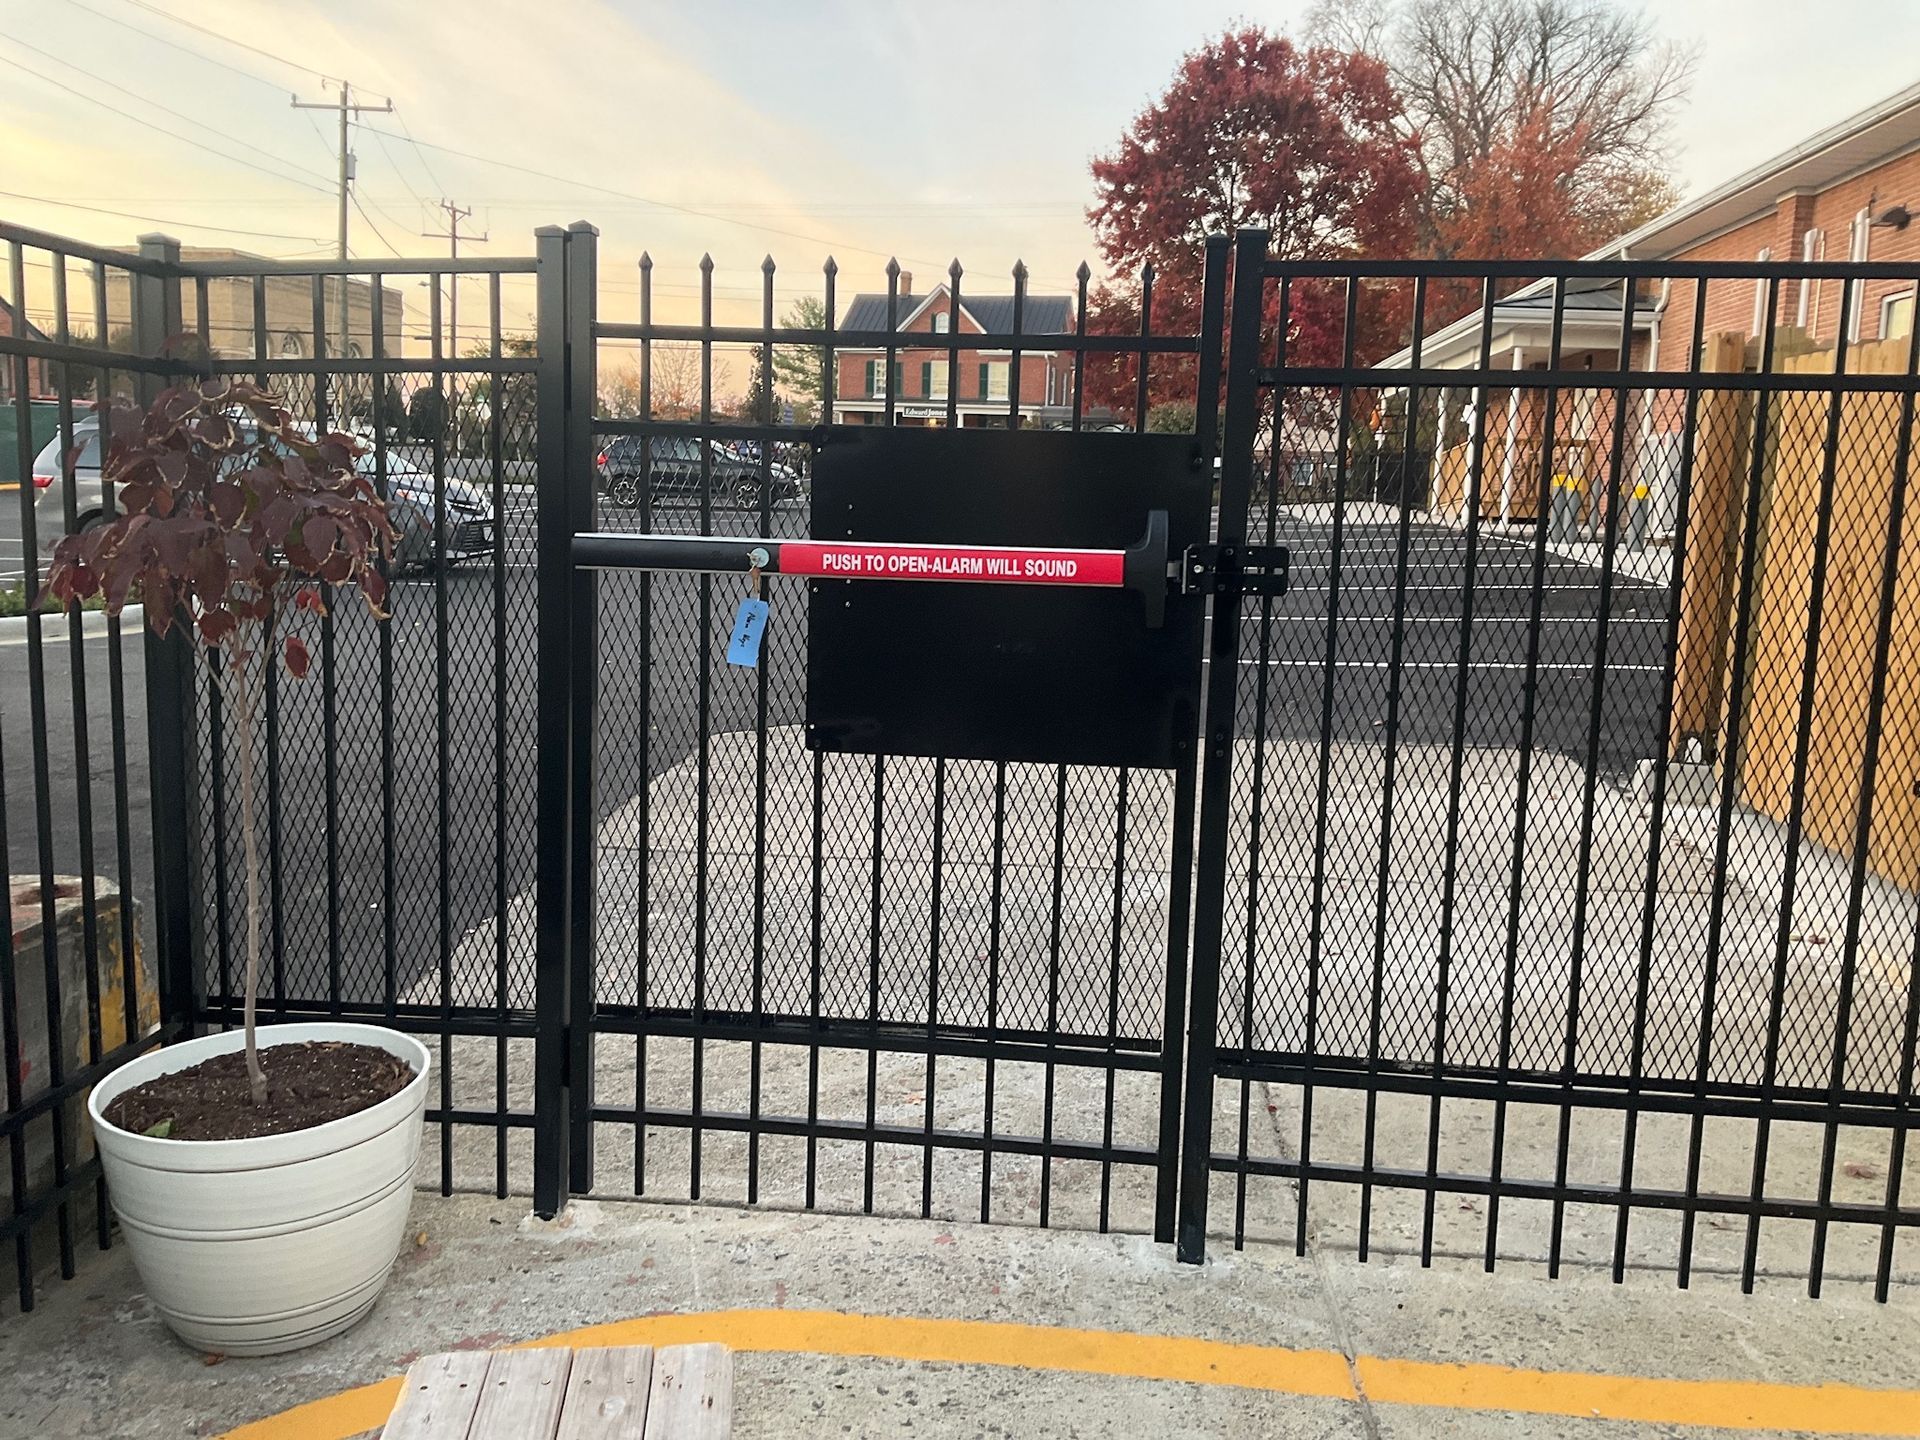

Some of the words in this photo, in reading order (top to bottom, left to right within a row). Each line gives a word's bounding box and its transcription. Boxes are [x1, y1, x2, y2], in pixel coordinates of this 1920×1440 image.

[905, 407, 928, 416] Edward
[822, 553, 861, 572] PUSH
[864, 554, 885, 572] TO
[887, 555, 983, 575] OPEN-ALARM
[985, 557, 1022, 576] WILL
[1024, 558, 1077, 578] SOUND
